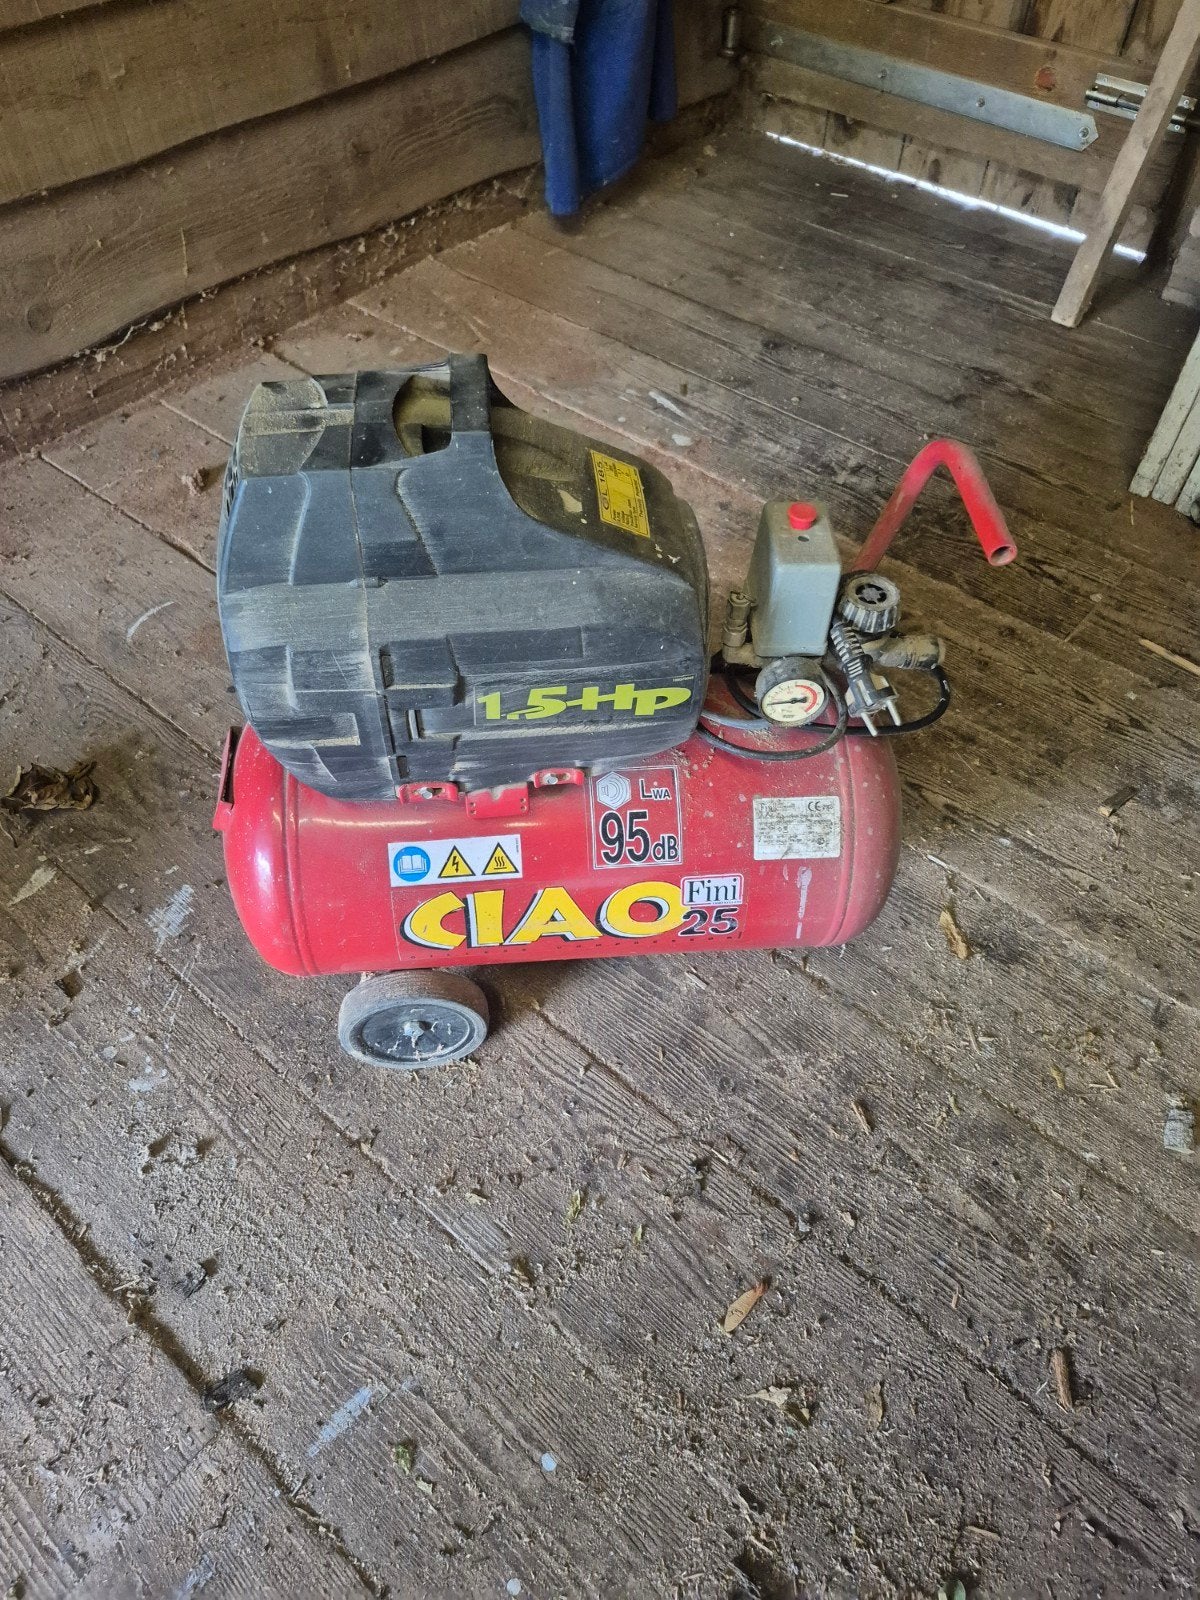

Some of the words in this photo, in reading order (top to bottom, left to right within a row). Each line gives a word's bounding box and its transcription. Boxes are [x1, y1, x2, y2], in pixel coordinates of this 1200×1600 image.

[687, 877, 739, 903] Fini
[401, 881, 684, 950] CIAO
[678, 907, 739, 936] 25
